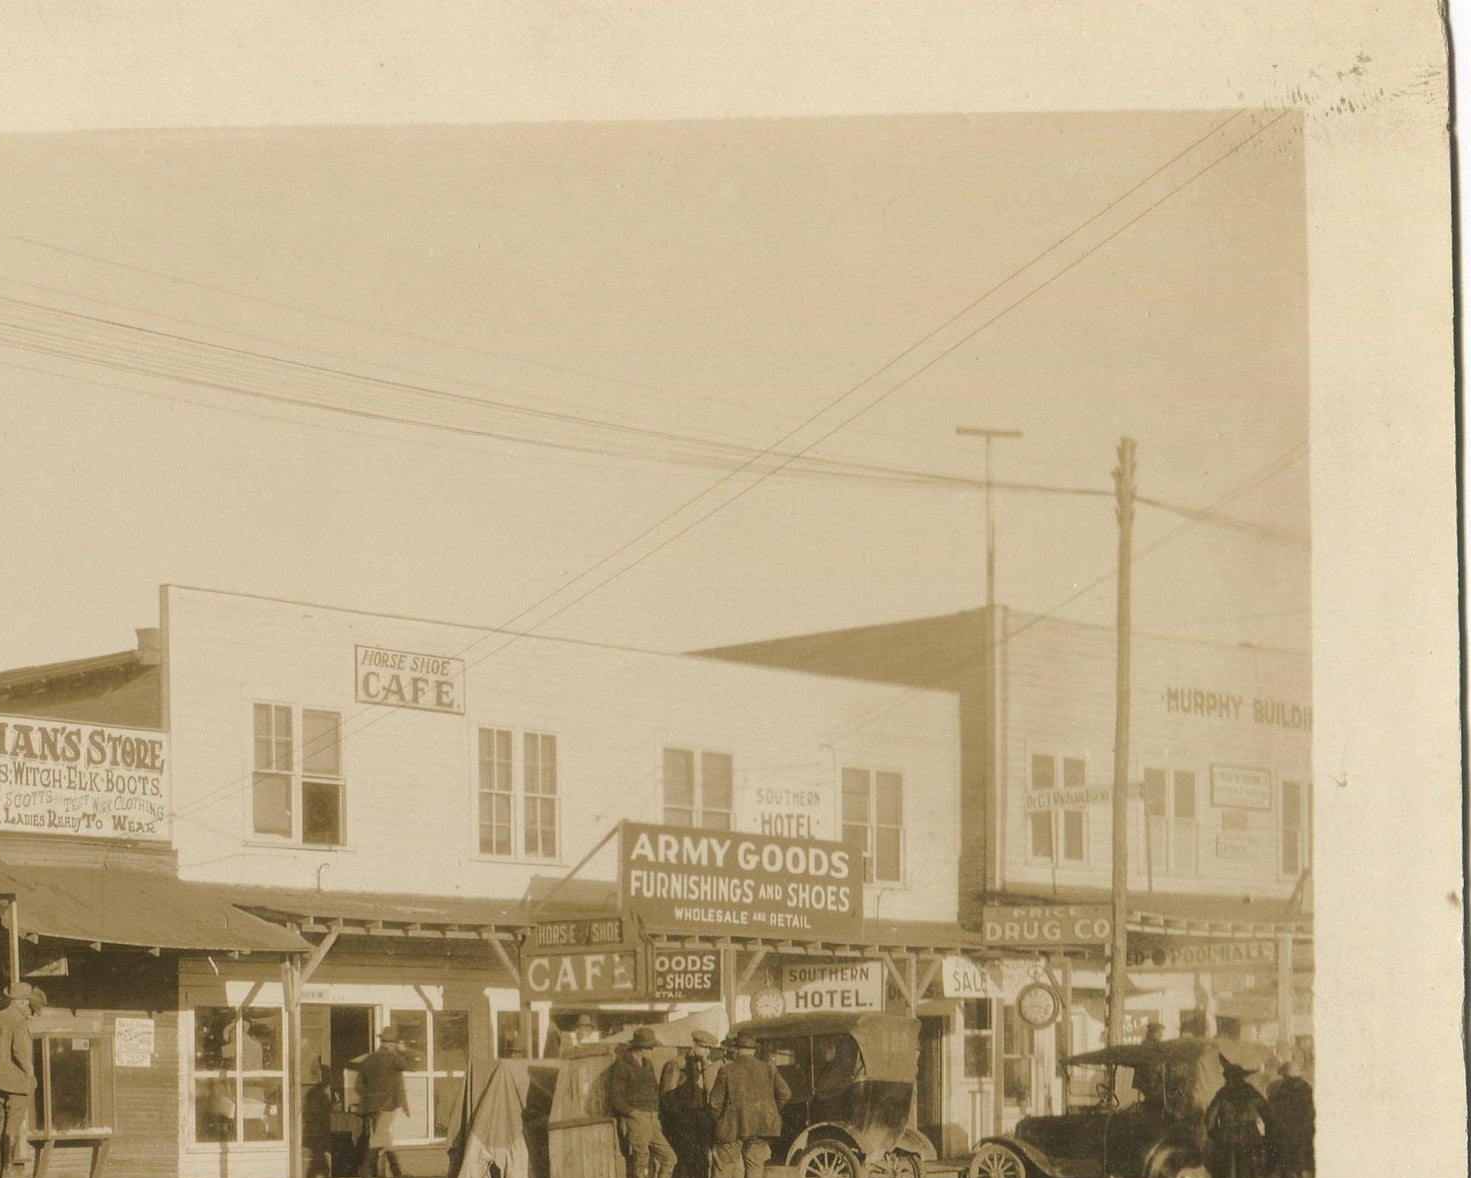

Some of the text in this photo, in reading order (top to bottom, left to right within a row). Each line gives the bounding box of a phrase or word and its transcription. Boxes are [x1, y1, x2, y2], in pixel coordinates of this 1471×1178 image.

[361, 648, 451, 676] HORSE SHOE
[1166, 686, 1244, 721] MURPHY
[86, 728, 165, 776] STORE
[114, 795, 165, 822] CLOTHING
[756, 787, 821, 807] SOUTHERN
[3, 805, 46, 828] LADIES
[81, 812, 104, 830] TO
[111, 814, 158, 834] WEAR
[630, 832, 850, 879] ARMY GOODS
[630, 869, 851, 913] FURNISHINGS AND SHOES
[674, 906, 812, 929] WHOLESALE AND RETAIL
[985, 920, 1063, 942] DRUG
[537, 921, 622, 945] HORSE SHOE
[527, 953, 634, 993] CAFE
[664, 973, 713, 990] SHOES
[788, 966, 870, 983] SOUTHERN
[952, 970, 988, 993] SALE
